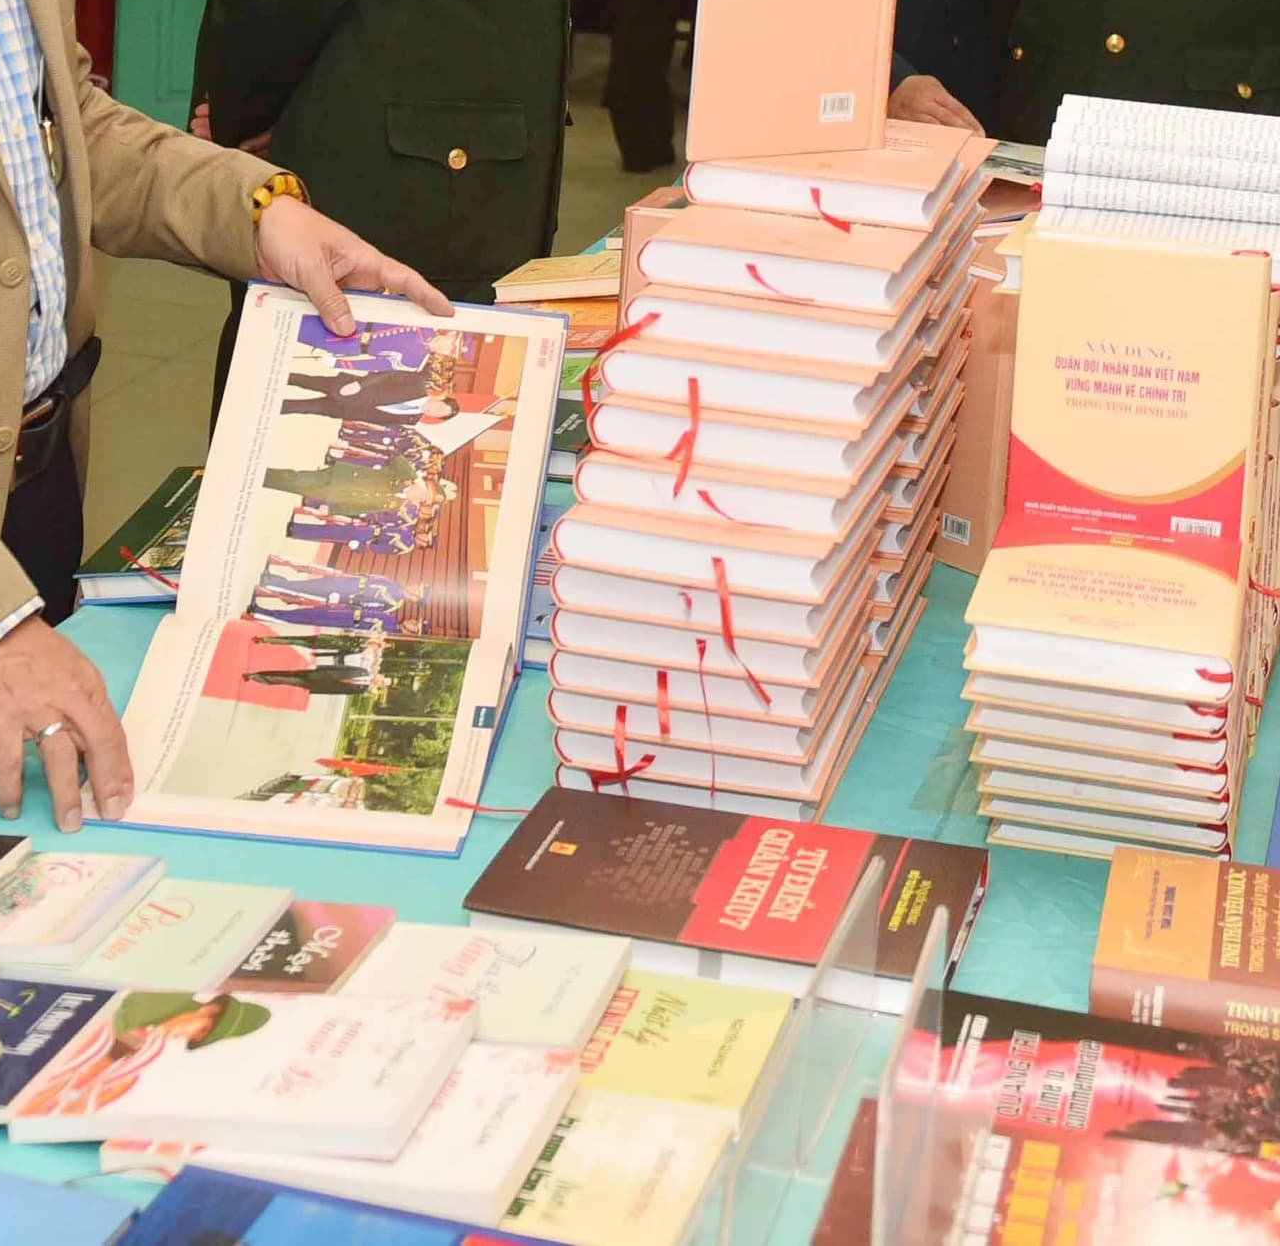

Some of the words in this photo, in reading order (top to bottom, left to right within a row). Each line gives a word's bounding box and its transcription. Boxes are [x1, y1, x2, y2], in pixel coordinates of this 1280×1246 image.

[1177, 370, 1200, 384] NAM
[746, 828, 795, 879] QUÂN
[791, 848, 829, 875] TỪ
[724, 875, 770, 922] KHU
[766, 873, 815, 922] ĐIỂN
[1226, 1002, 1267, 1022] TINH
[1223, 1020, 1269, 1038] TRONG
